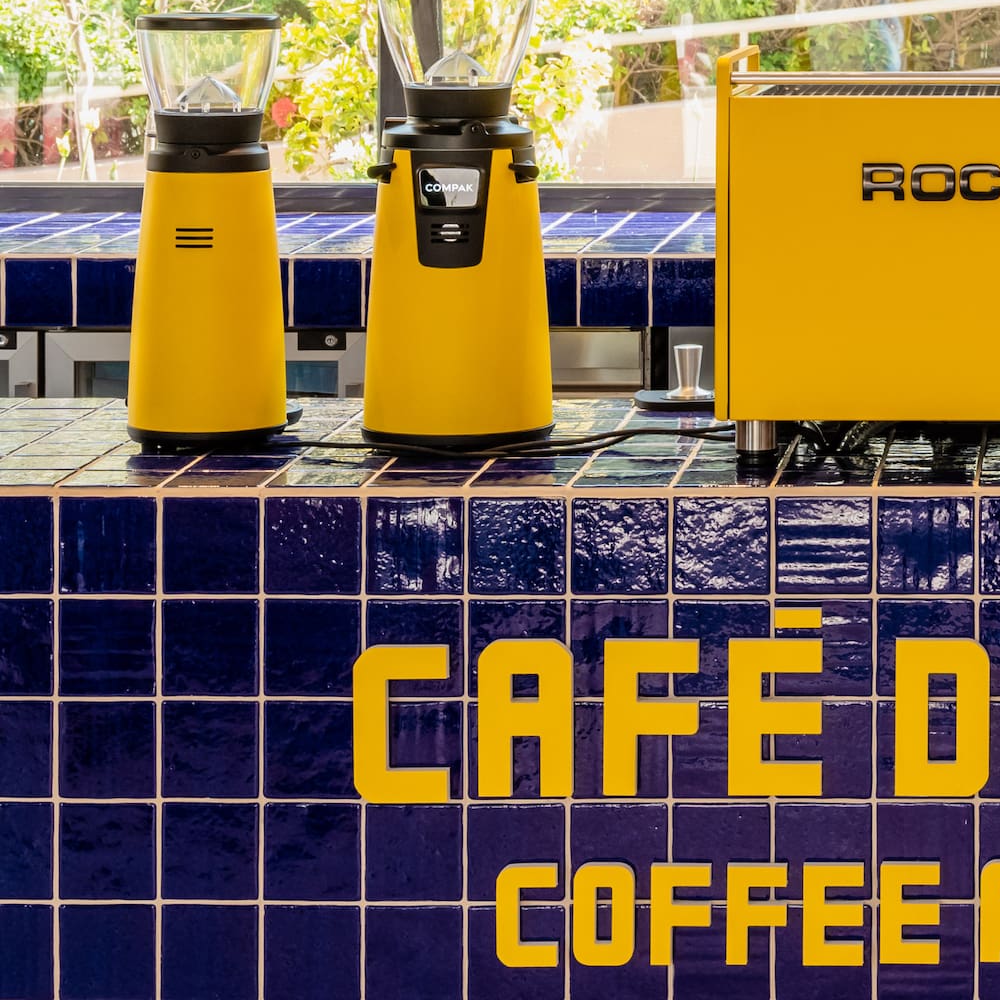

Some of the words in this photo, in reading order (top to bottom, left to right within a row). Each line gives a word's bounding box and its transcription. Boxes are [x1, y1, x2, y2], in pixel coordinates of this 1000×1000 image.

[424, 183, 474, 193] COMPAK
[352, 606, 824, 804] CAFÉ
[495, 861, 942, 968] COFFEE
